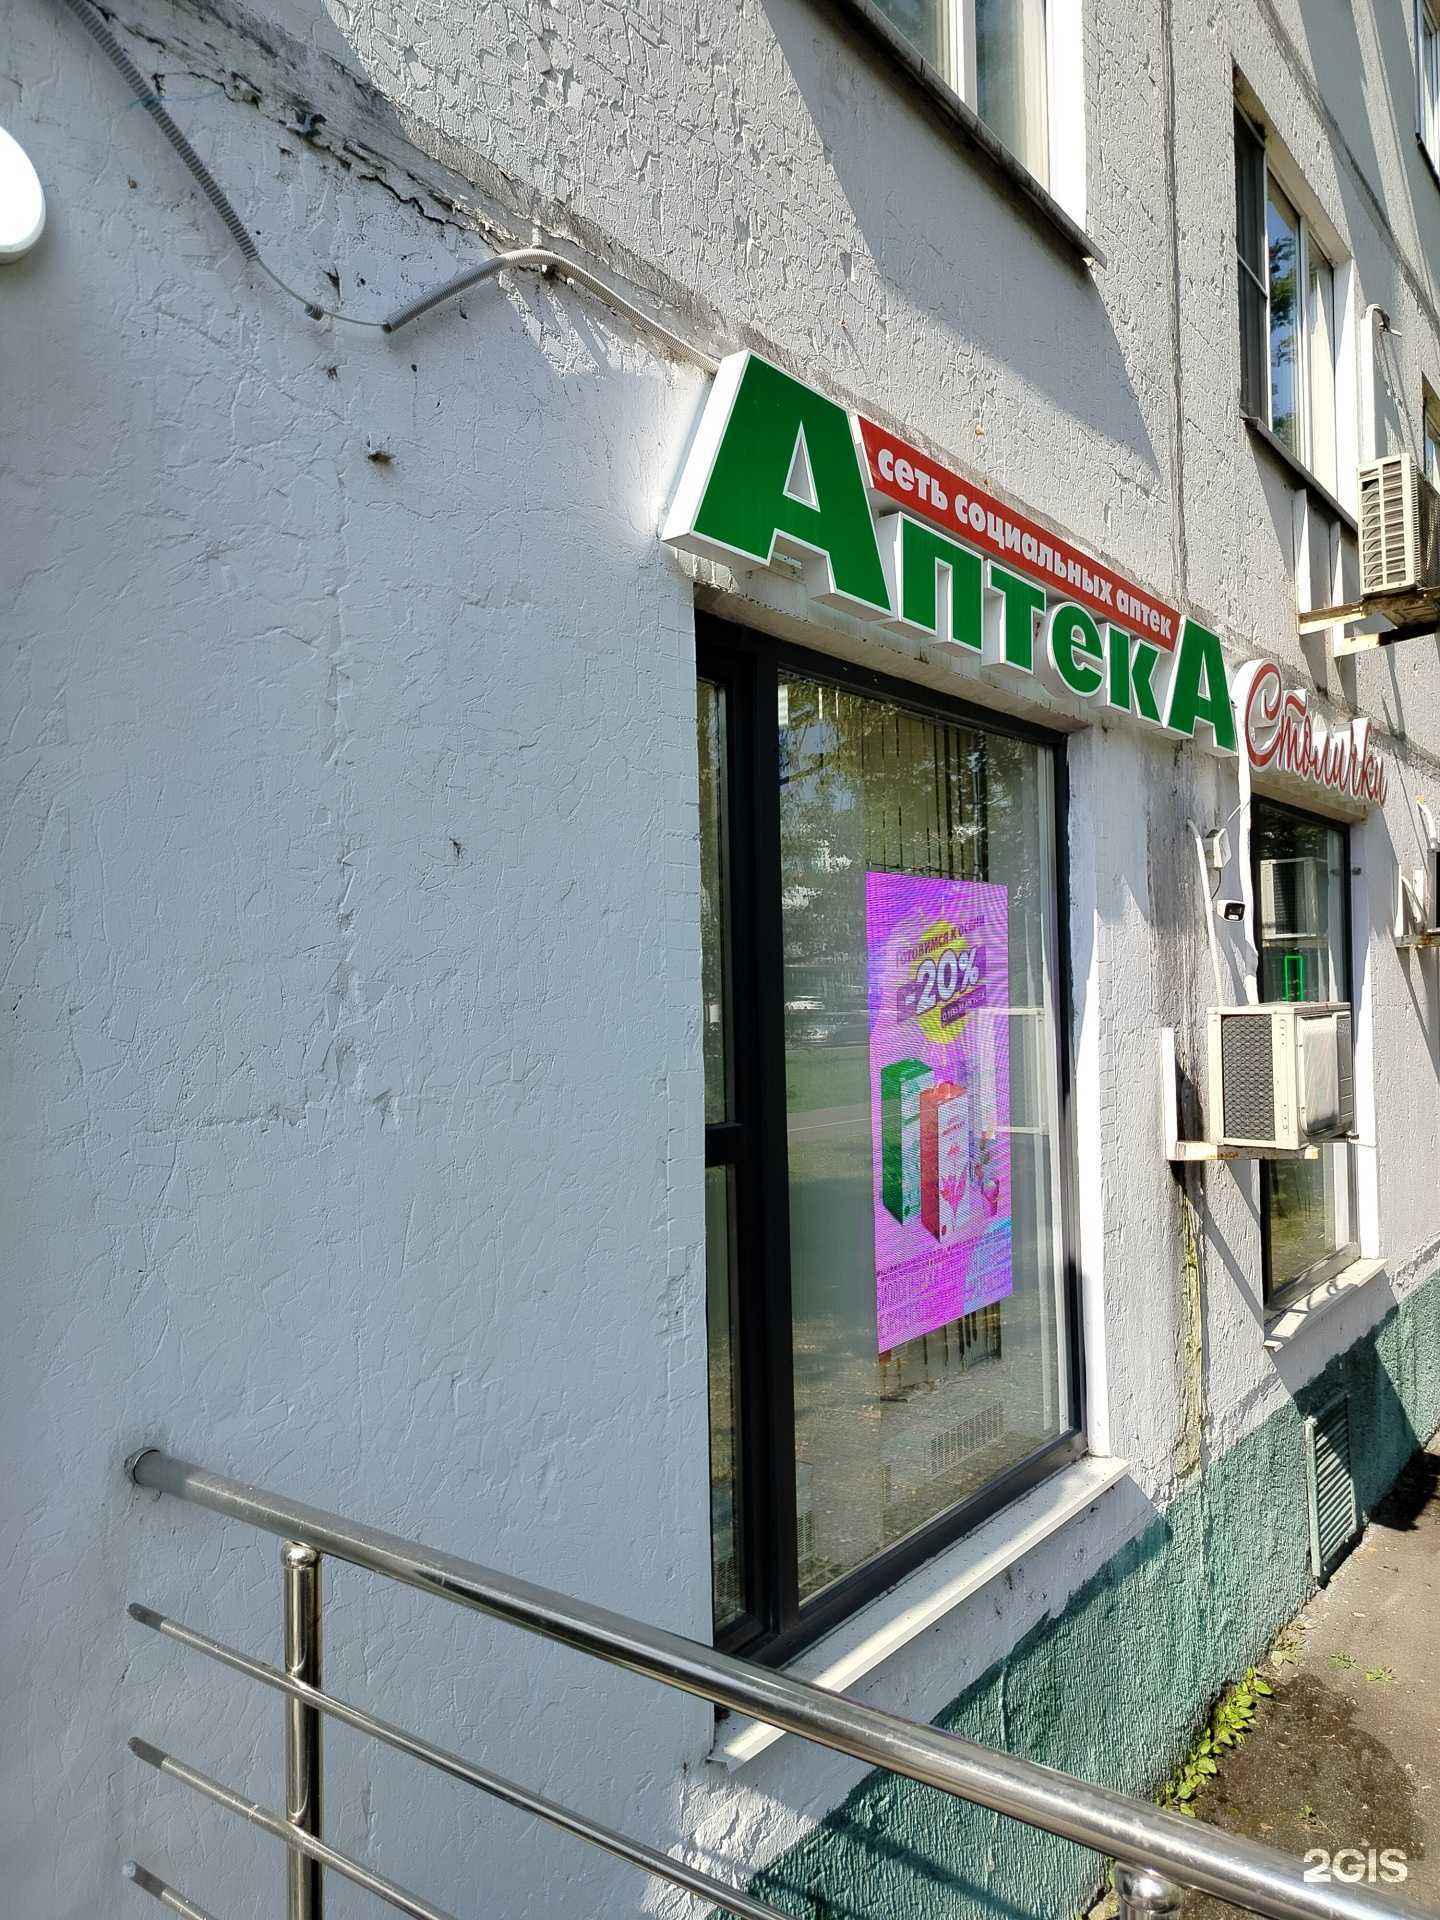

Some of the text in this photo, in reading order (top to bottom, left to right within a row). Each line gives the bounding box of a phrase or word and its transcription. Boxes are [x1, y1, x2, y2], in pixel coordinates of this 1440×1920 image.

[877, 448, 1172, 640] сеть социальных аптек
[1244, 659, 1388, 807] Столички
[903, 946, 980, 1016] -20%
